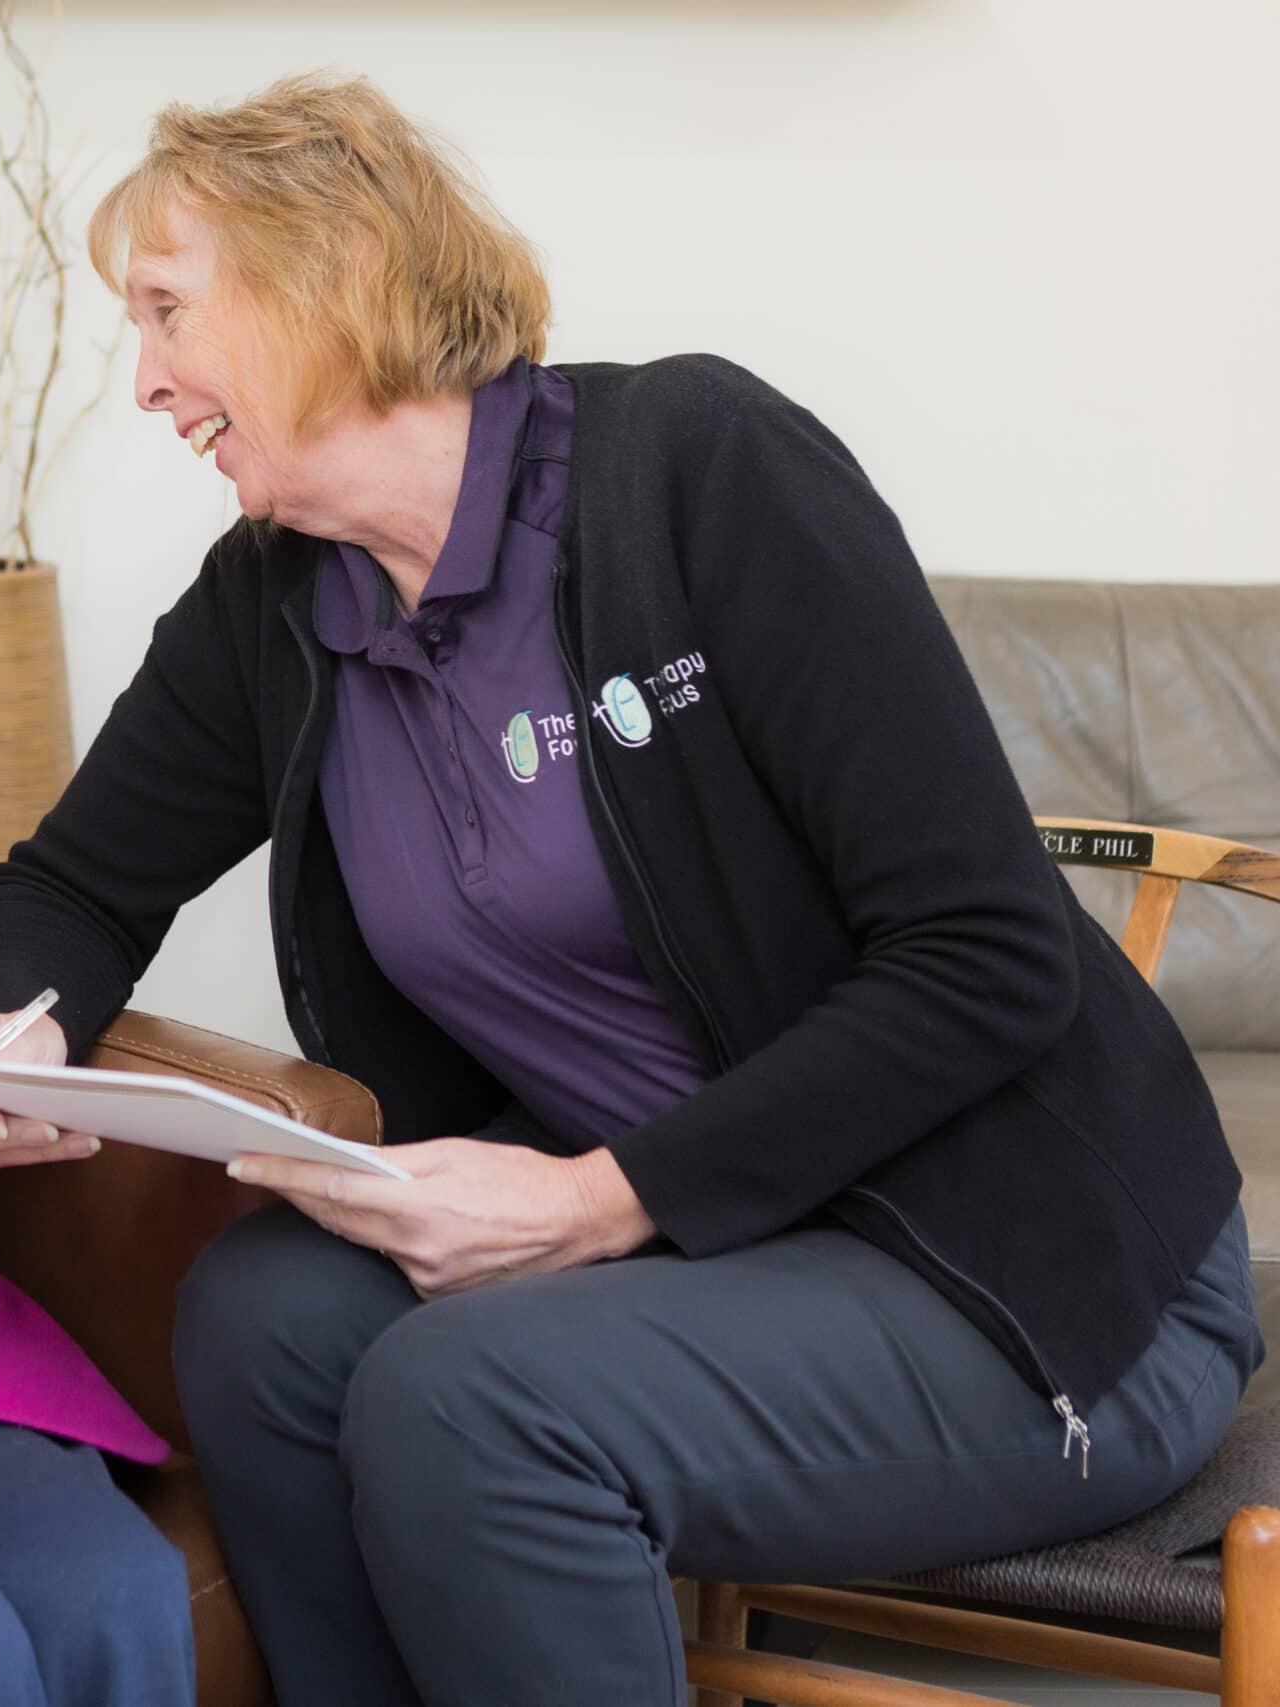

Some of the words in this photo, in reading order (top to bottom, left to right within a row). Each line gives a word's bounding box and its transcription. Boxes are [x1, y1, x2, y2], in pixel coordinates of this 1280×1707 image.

[547, 738, 578, 761] Fo
[1040, 833, 1083, 854] CLE
[1092, 837, 1139, 858] PHIL
